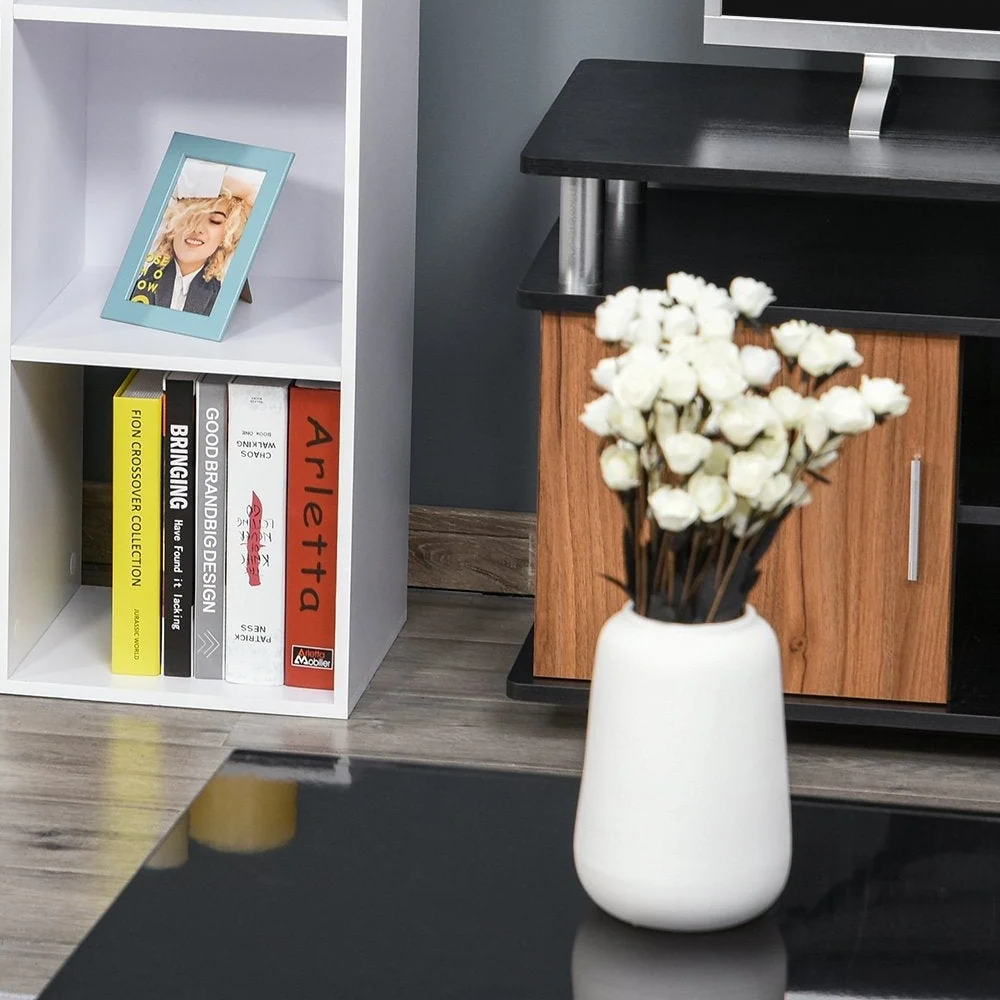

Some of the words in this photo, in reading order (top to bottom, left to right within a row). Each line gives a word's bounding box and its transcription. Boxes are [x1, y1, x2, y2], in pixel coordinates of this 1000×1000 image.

[130, 408, 143, 439] FION
[204, 406, 220, 459] GOOD
[235, 440, 277, 449] WALKING
[240, 450, 273, 460] CHAOS
[130, 440, 143, 513] CROSSOVER
[168, 423, 189, 511] BRINGING
[300, 415, 334, 613] Arletta
[172, 518, 185, 542] Have
[130, 514, 143, 588] COLLECTION
[172, 544, 185, 574] Found
[172, 578, 184, 589] it
[133, 607, 141, 637] JURASSIC
[170, 593, 184, 631] lacking
[233, 633, 272, 643] PATRICK
[240, 624, 267, 633] NESS
[133, 638, 141, 661] WORLD
